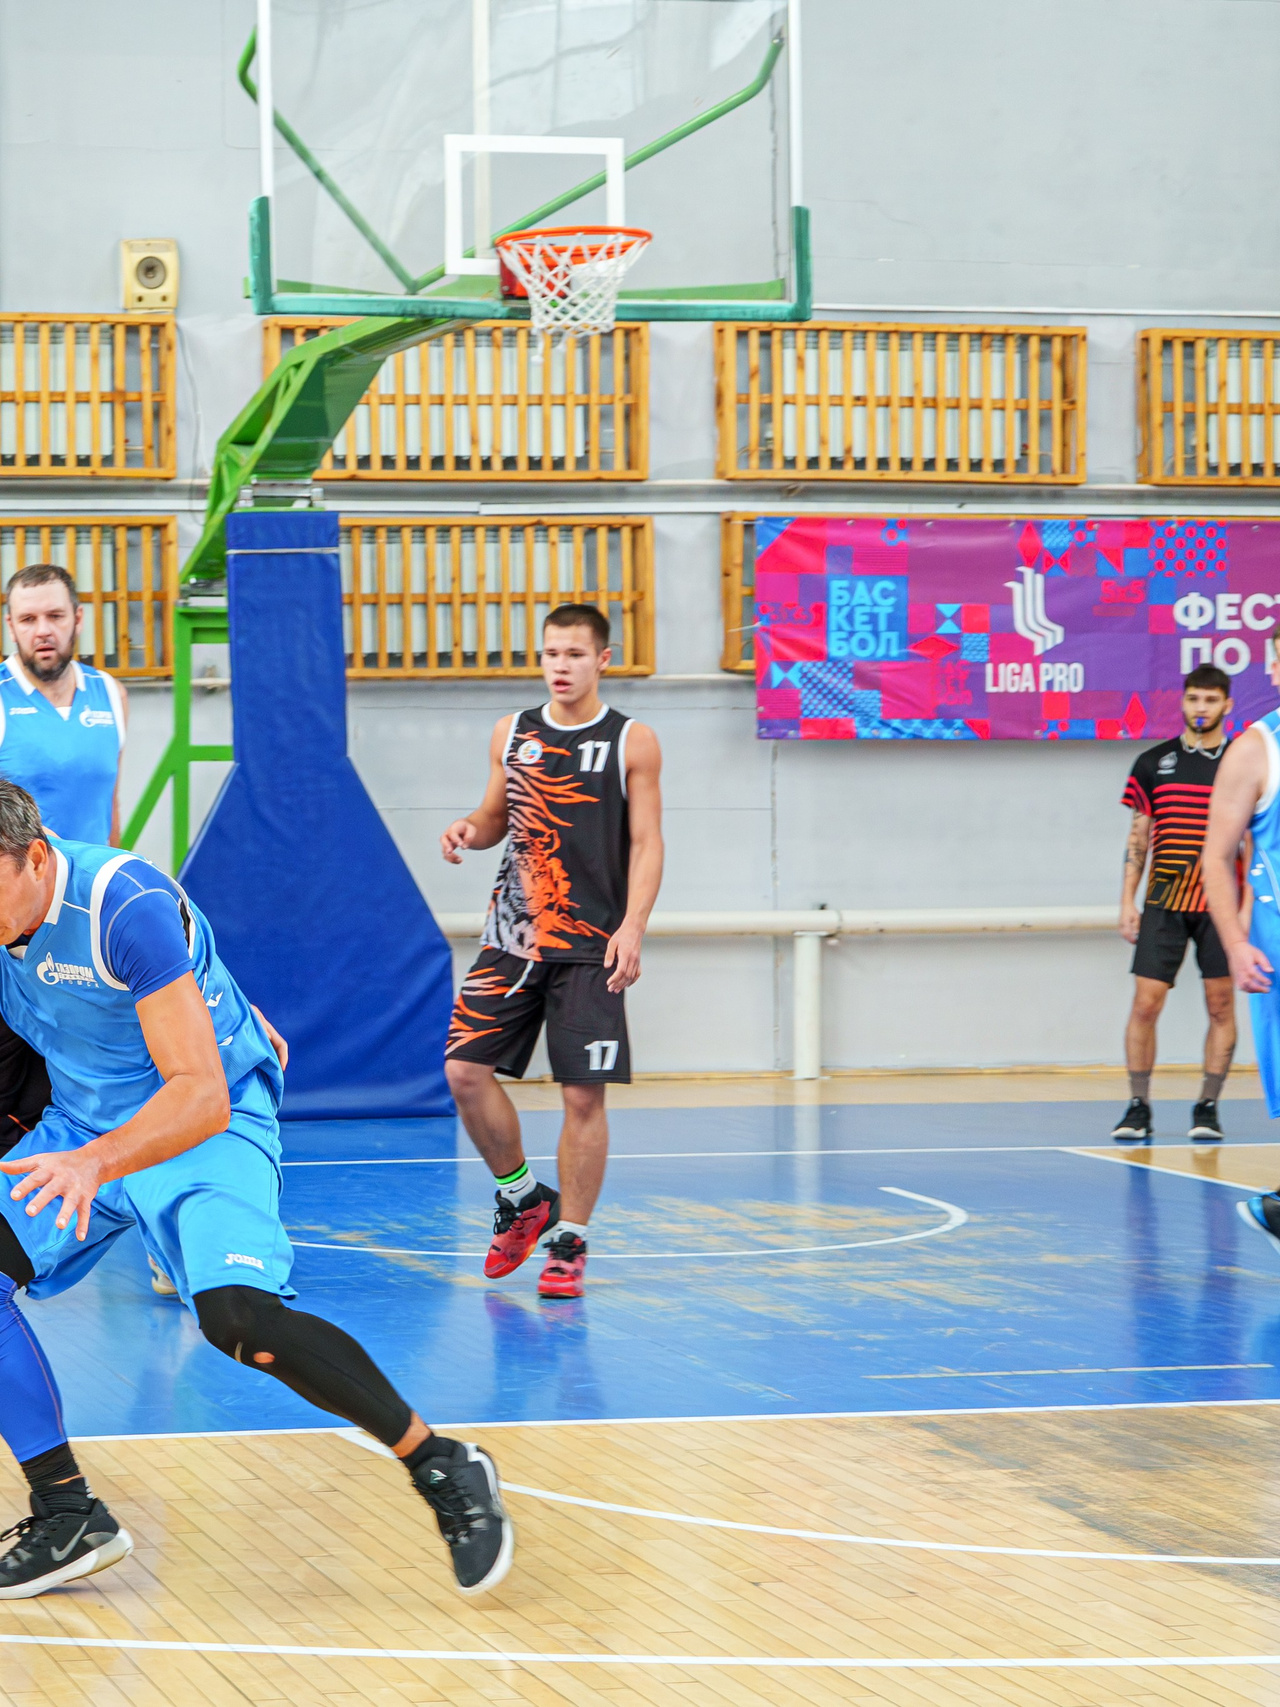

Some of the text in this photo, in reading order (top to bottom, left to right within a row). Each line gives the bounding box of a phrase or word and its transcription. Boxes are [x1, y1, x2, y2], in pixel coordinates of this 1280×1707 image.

[830, 580, 898, 606] БАС
[830, 605, 895, 632] КЕТ
[1173, 592, 1280, 631] ФЕС
[830, 631, 899, 657] БОЛ
[1180, 637, 1251, 675] ПО
[985, 662, 1084, 693] LIGA PRO
[577, 740, 612, 773] 17
[584, 1040, 619, 1071] 17
